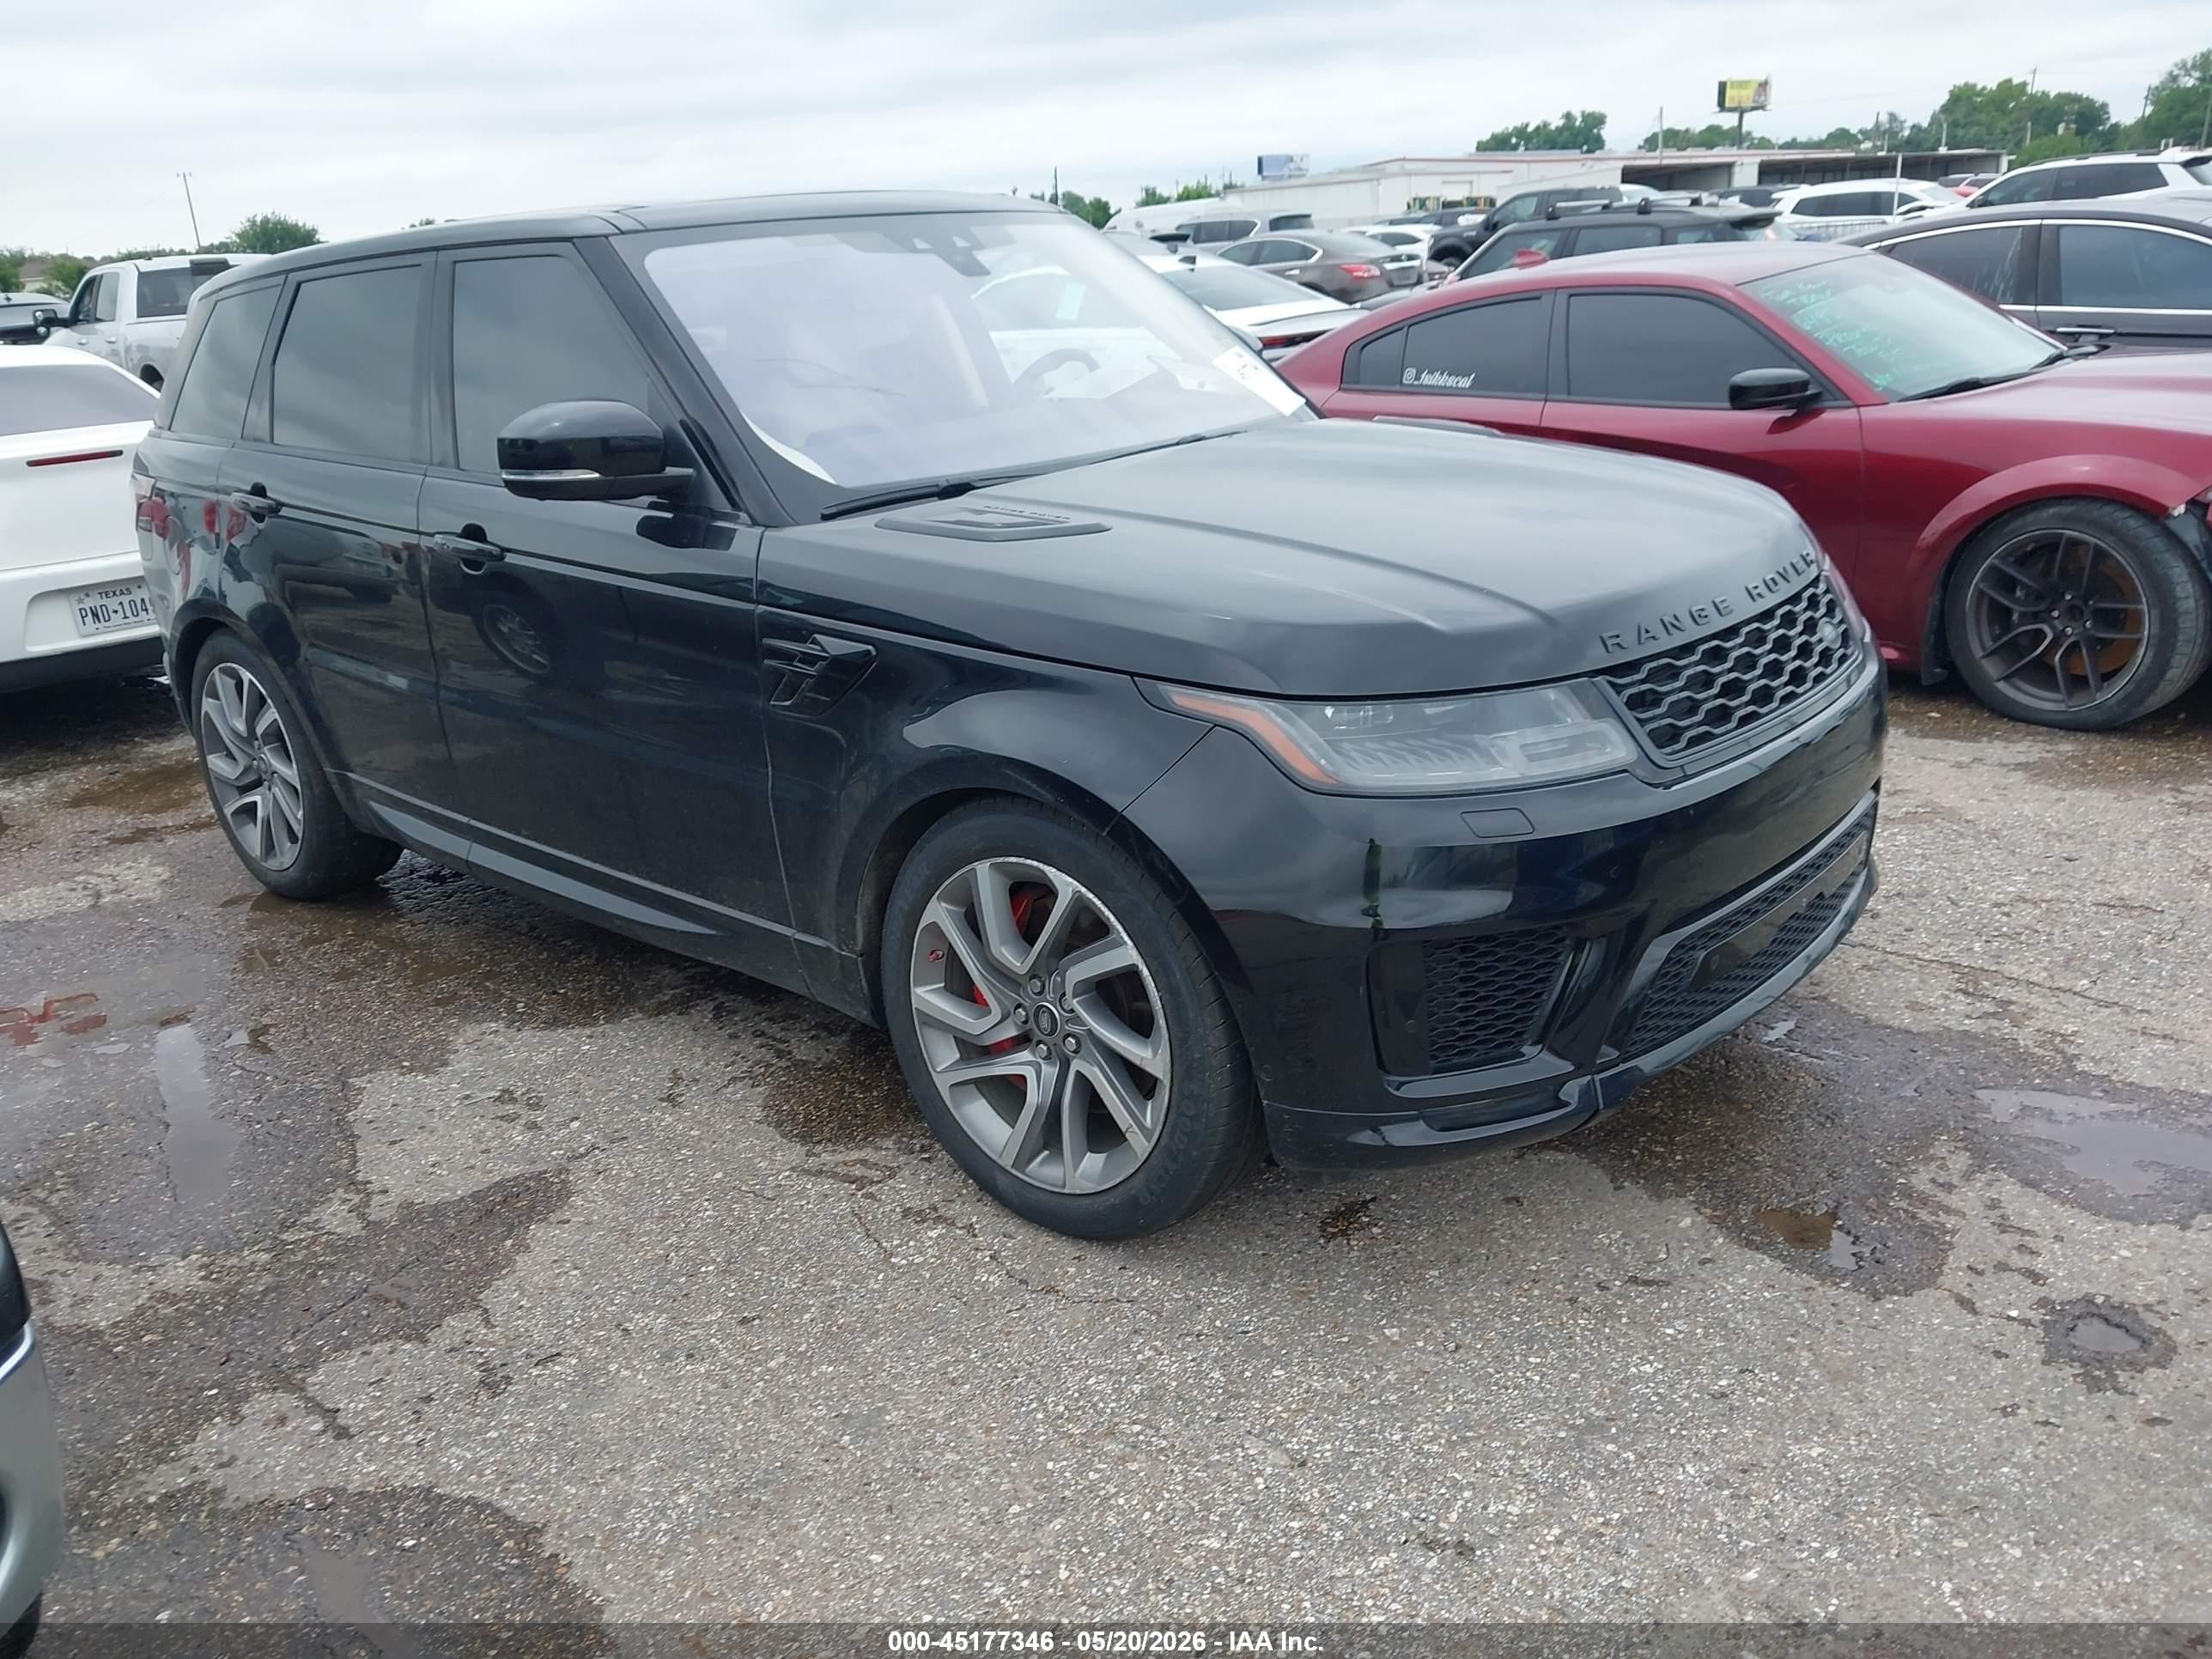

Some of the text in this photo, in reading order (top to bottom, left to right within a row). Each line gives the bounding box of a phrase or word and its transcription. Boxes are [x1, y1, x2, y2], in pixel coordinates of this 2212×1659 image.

[97, 587, 132, 599] TEXAS
[1600, 551, 1816, 654] RANGE ROVER
